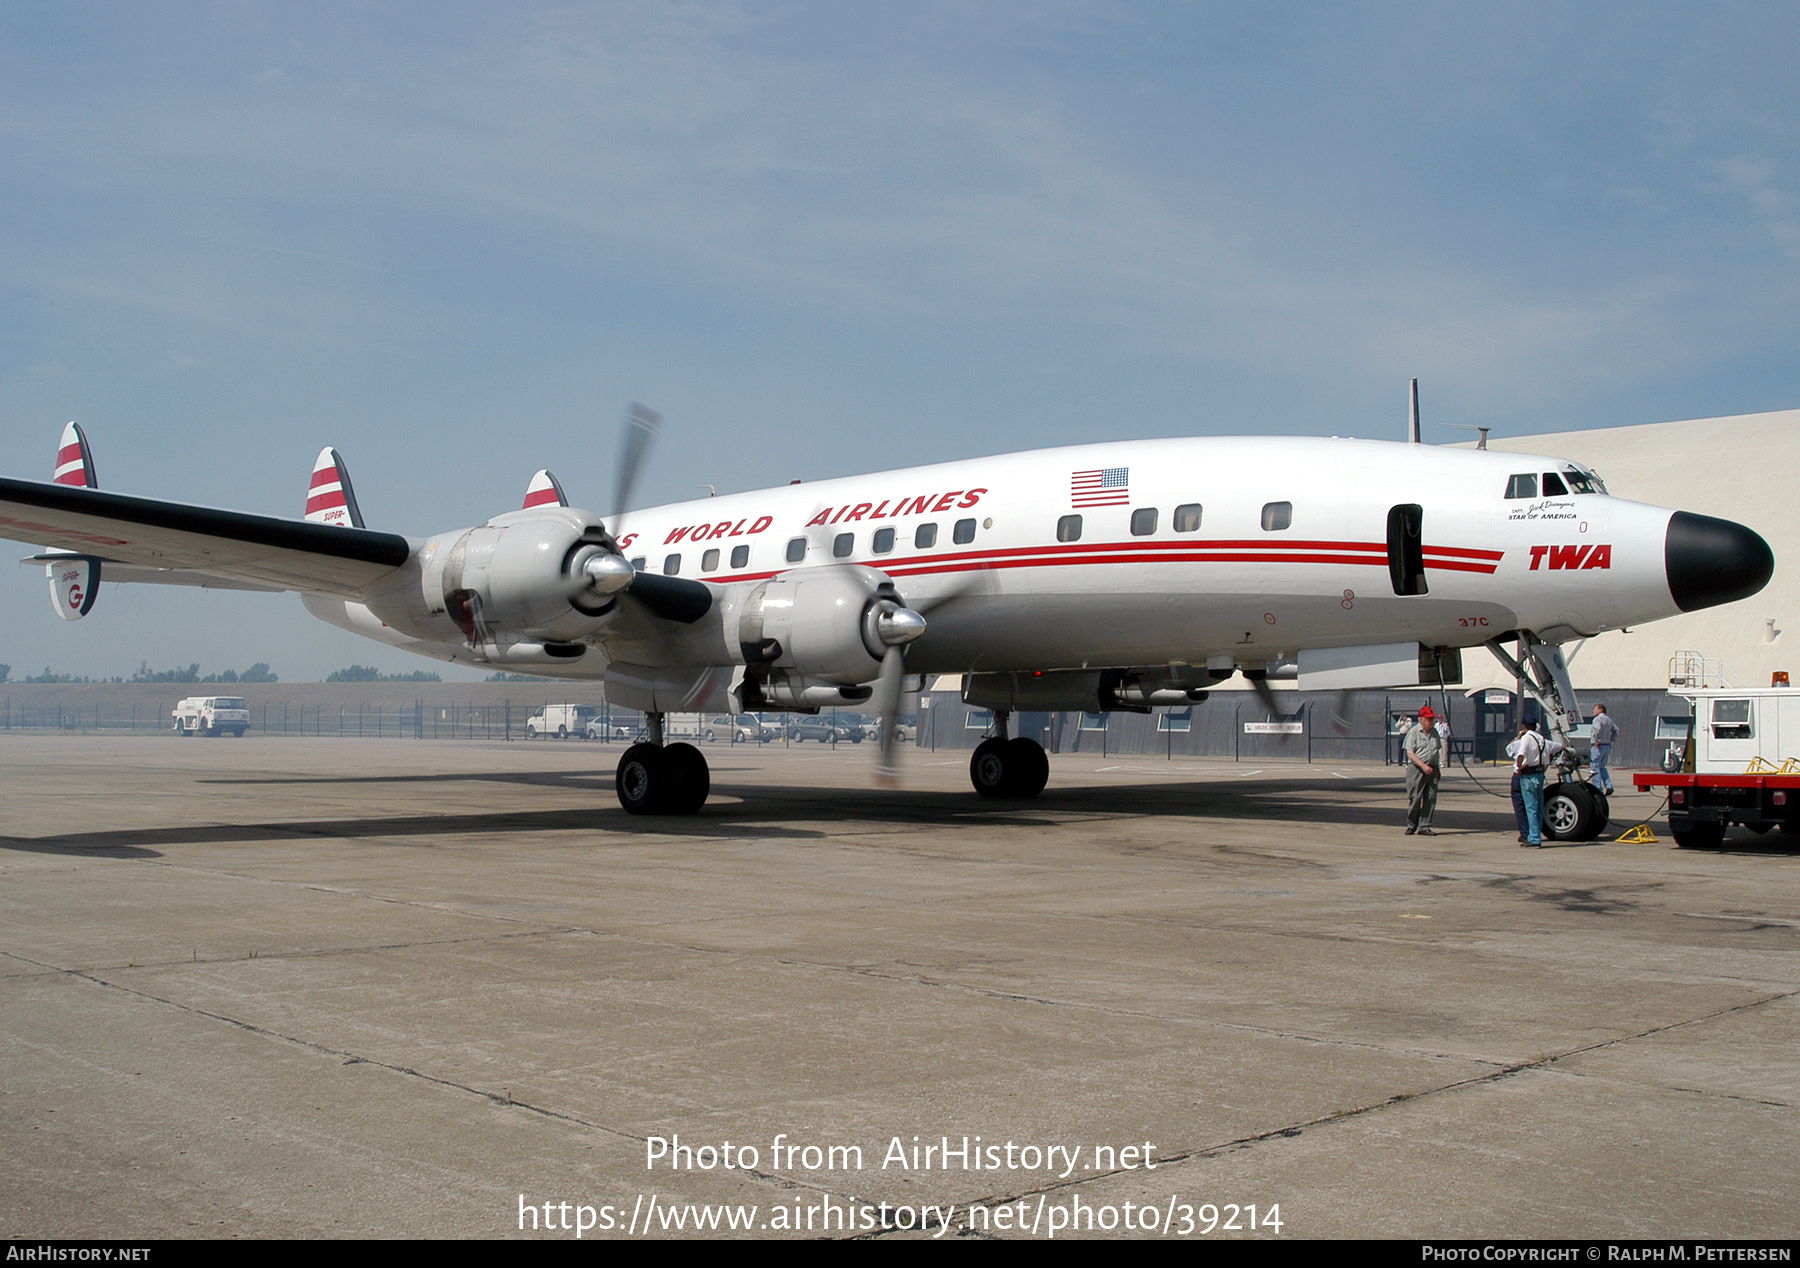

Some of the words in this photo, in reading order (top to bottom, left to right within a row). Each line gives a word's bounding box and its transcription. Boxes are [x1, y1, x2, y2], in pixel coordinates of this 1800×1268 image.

[615, 533, 639, 551] S
[663, 515, 774, 545] WORLD
[804, 488, 989, 528] AIRLINES
[1529, 545, 1612, 571] TWA
[69, 584, 84, 609] G
[1458, 617, 1490, 627] 37C
